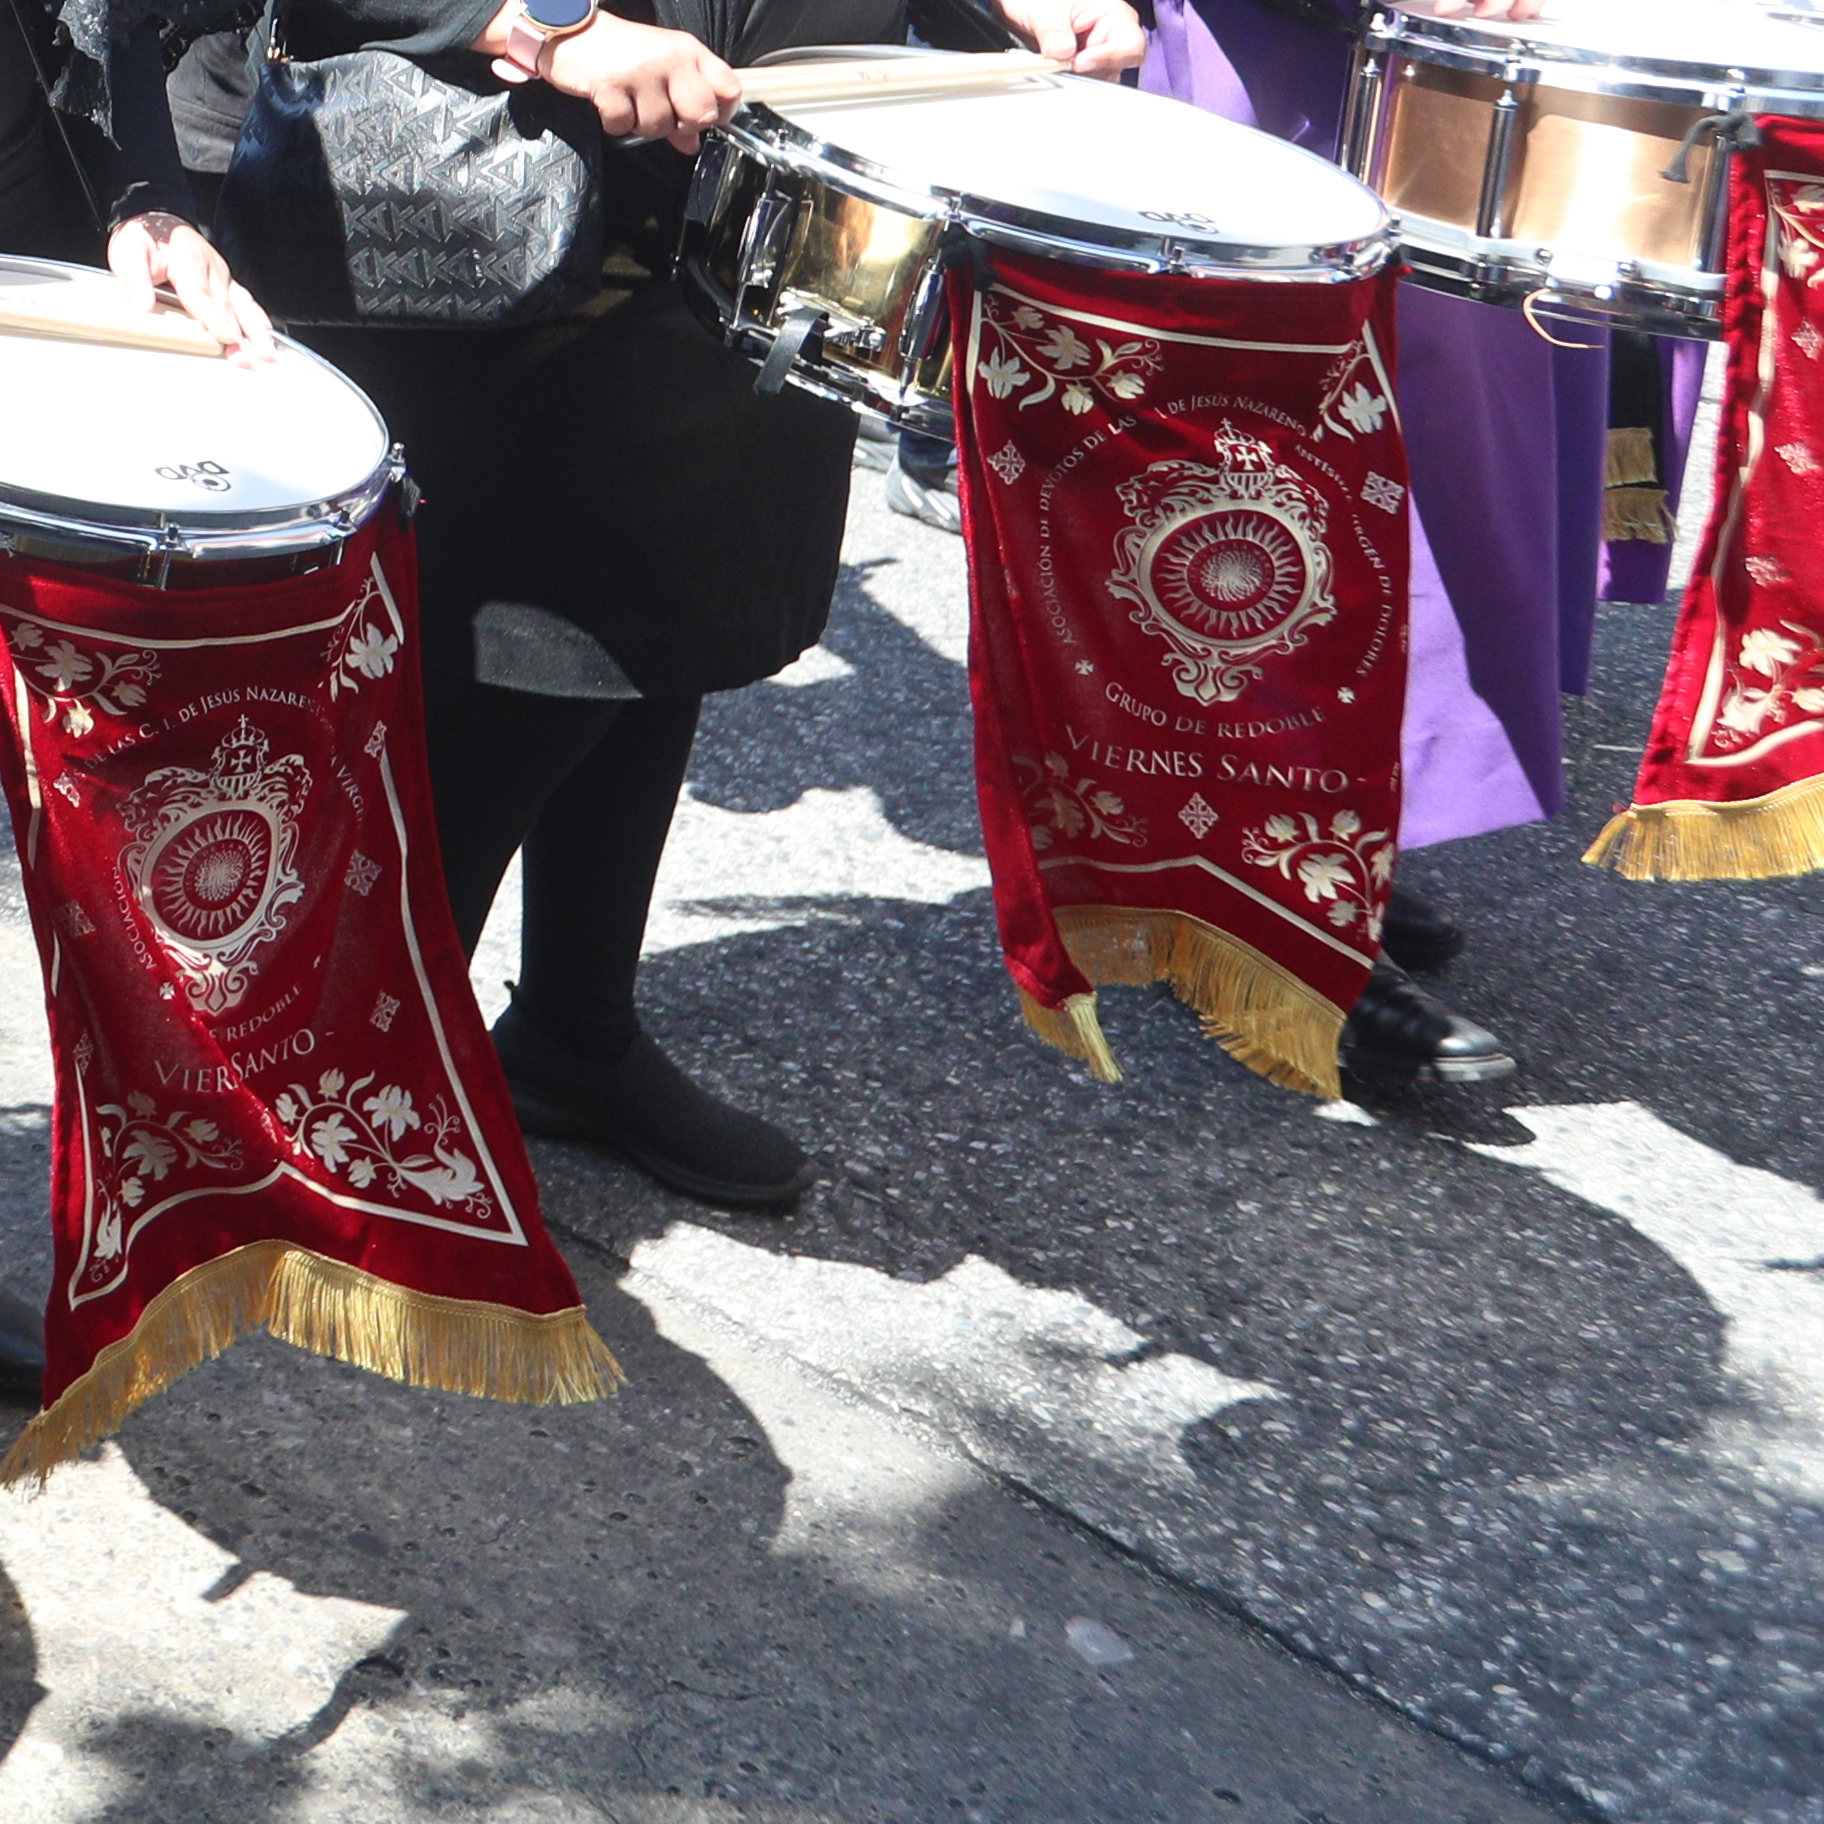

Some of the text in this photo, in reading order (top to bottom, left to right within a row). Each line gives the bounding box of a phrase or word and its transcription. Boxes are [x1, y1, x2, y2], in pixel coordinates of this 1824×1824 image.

[1083, 429, 1107, 450] DE
[1167, 399, 1186, 415] DE
[178, 703, 199, 723] DE
[200, 686, 241, 715] JESÚS
[1105, 681, 1327, 739] GRUPO DE REDOBLE
[1066, 724, 1350, 793] VIERNES SANTO
[230, 1028, 315, 1082] SANTO
